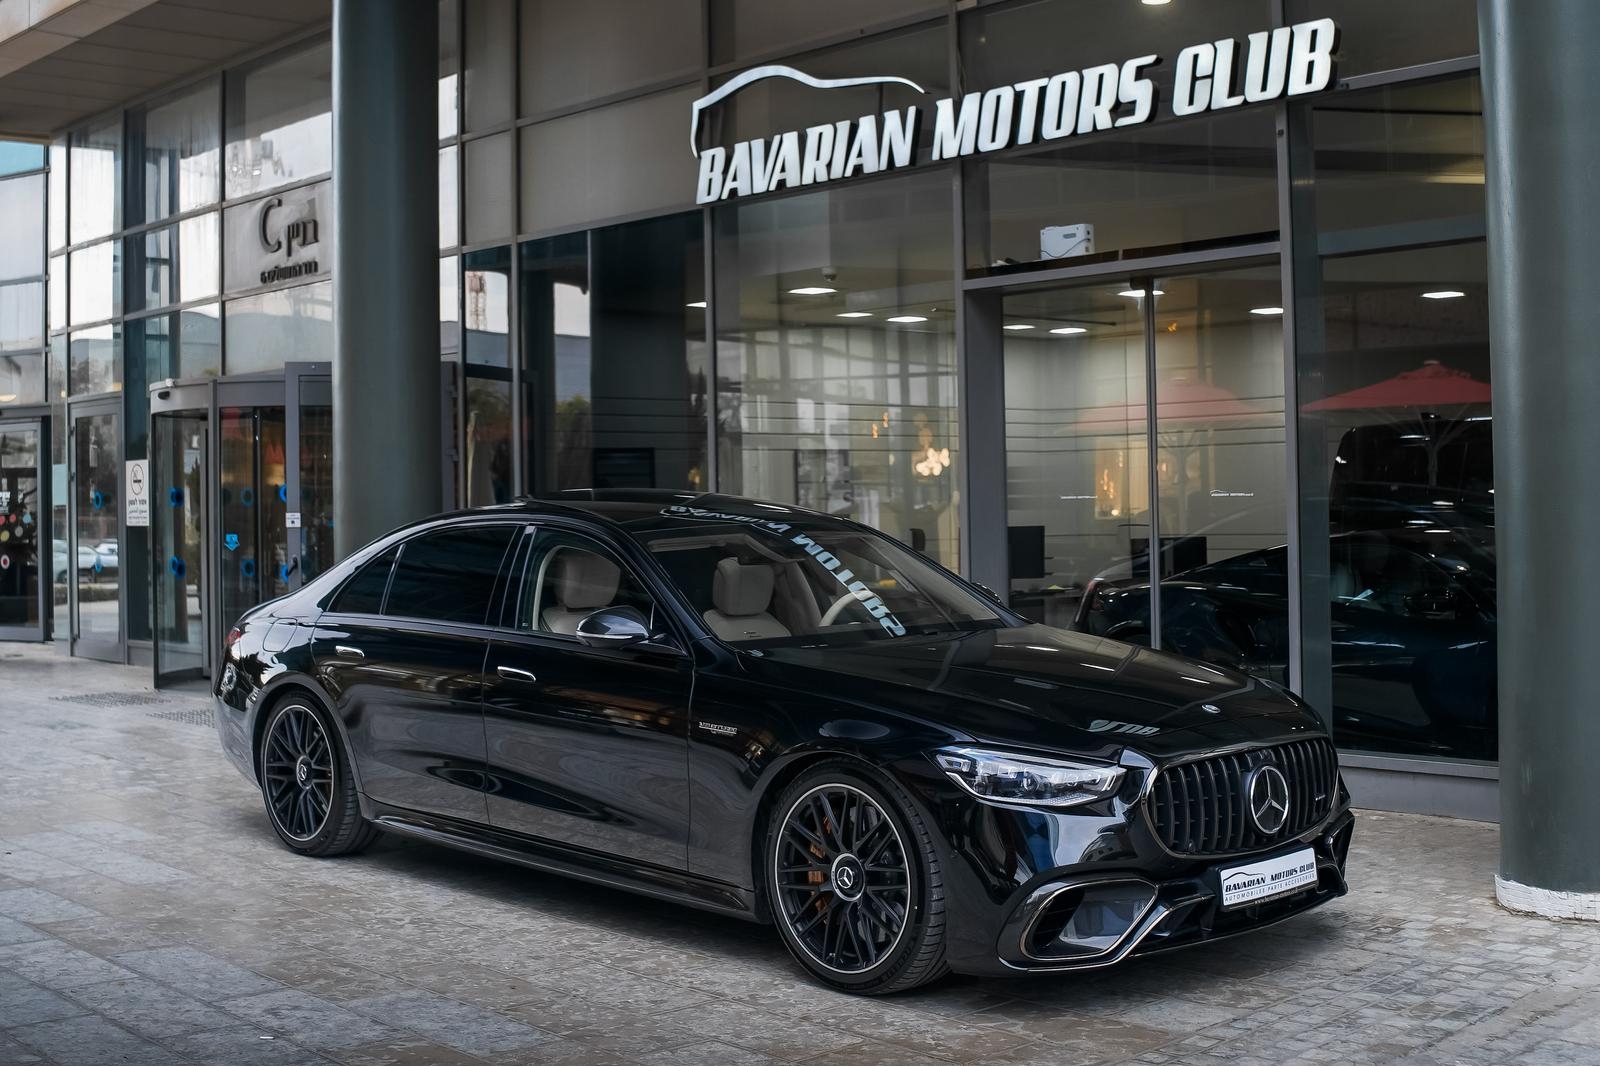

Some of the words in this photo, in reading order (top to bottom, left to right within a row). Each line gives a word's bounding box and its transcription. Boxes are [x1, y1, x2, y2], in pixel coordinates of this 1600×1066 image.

[696, 105, 917, 205] BAVARIAN
[932, 54, 1158, 160] MOTORS
[1172, 18, 1336, 116] CLUB
[259, 198, 282, 254] C
[1225, 876, 1266, 892] BAVARIAN
[1270, 867, 1298, 882] MOTORS
[1299, 861, 1315, 873] CLUB
